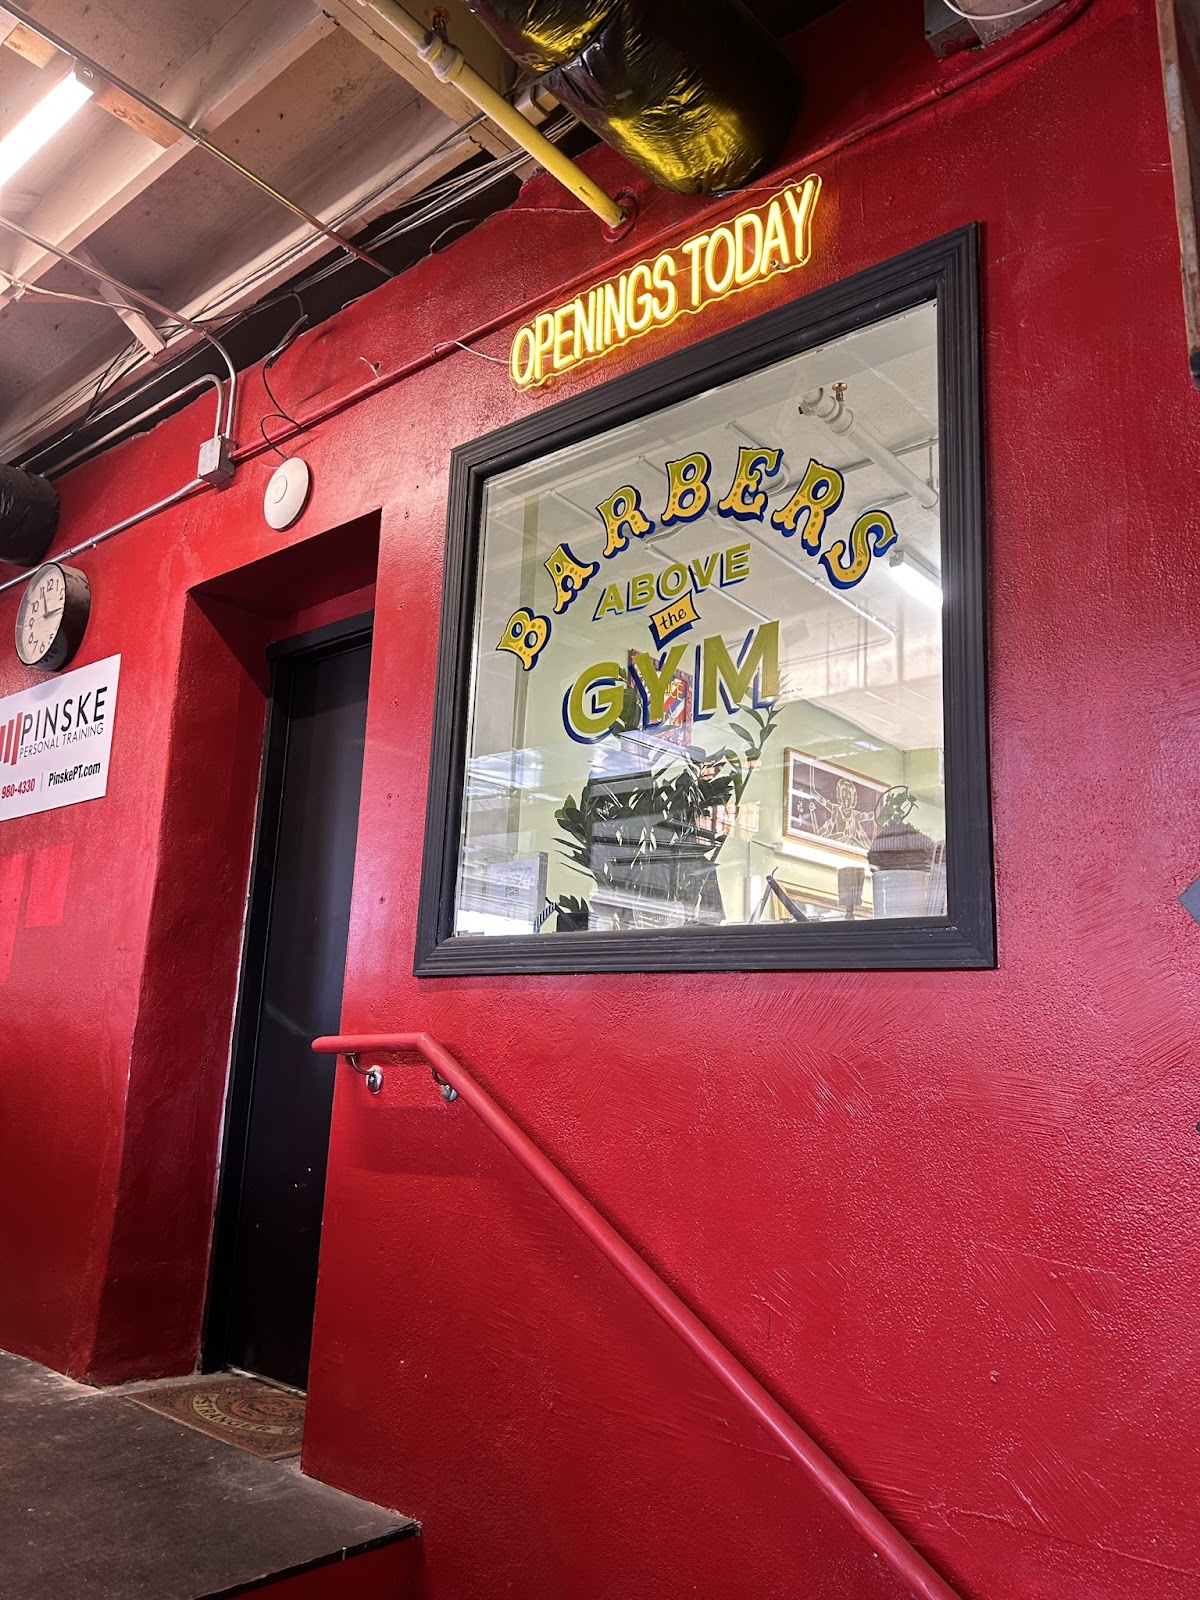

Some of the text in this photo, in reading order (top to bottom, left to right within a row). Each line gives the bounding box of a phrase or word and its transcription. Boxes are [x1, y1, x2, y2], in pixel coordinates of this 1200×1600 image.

[511, 179, 816, 386] OPENINGS TODAY
[496, 446, 899, 671] BARBERS
[46, 578, 54, 592] 12
[592, 542, 752, 621] ABOVE
[29, 618, 34, 629] 9
[32, 600, 39, 614] 10
[659, 606, 688, 632] the
[32, 640, 38, 654] 7
[40, 643, 45, 654] 6
[562, 620, 781, 744] GYM
[20, 685, 107, 745] PINSKE
[19, 722, 104, 759] PERSONAL TRAINING
[1, 762, 101, 799] 980-4330 PinskePT.com
